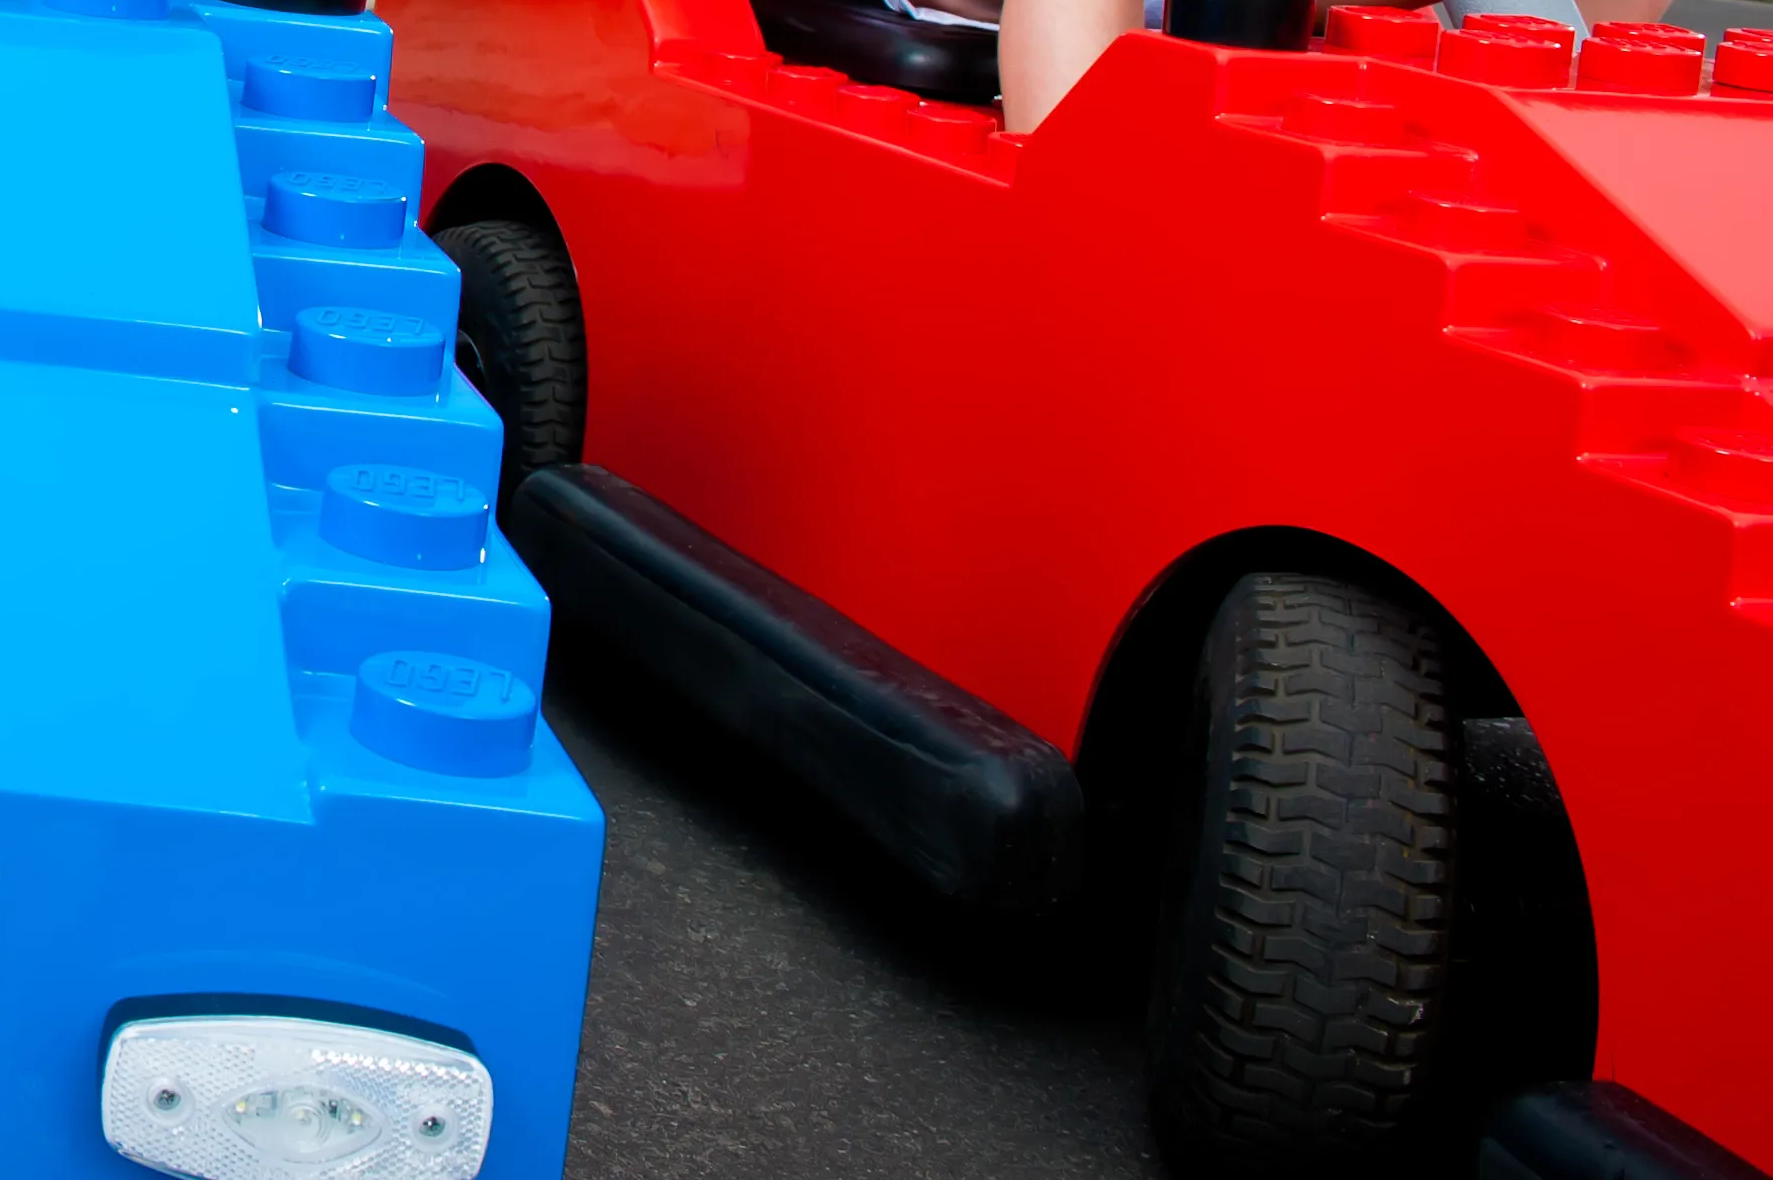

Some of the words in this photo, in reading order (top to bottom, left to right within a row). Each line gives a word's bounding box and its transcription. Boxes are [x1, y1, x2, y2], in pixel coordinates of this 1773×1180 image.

[318, 309, 425, 336] LEGO
[352, 470, 465, 503] LEGO
[385, 659, 513, 704] LEGO
